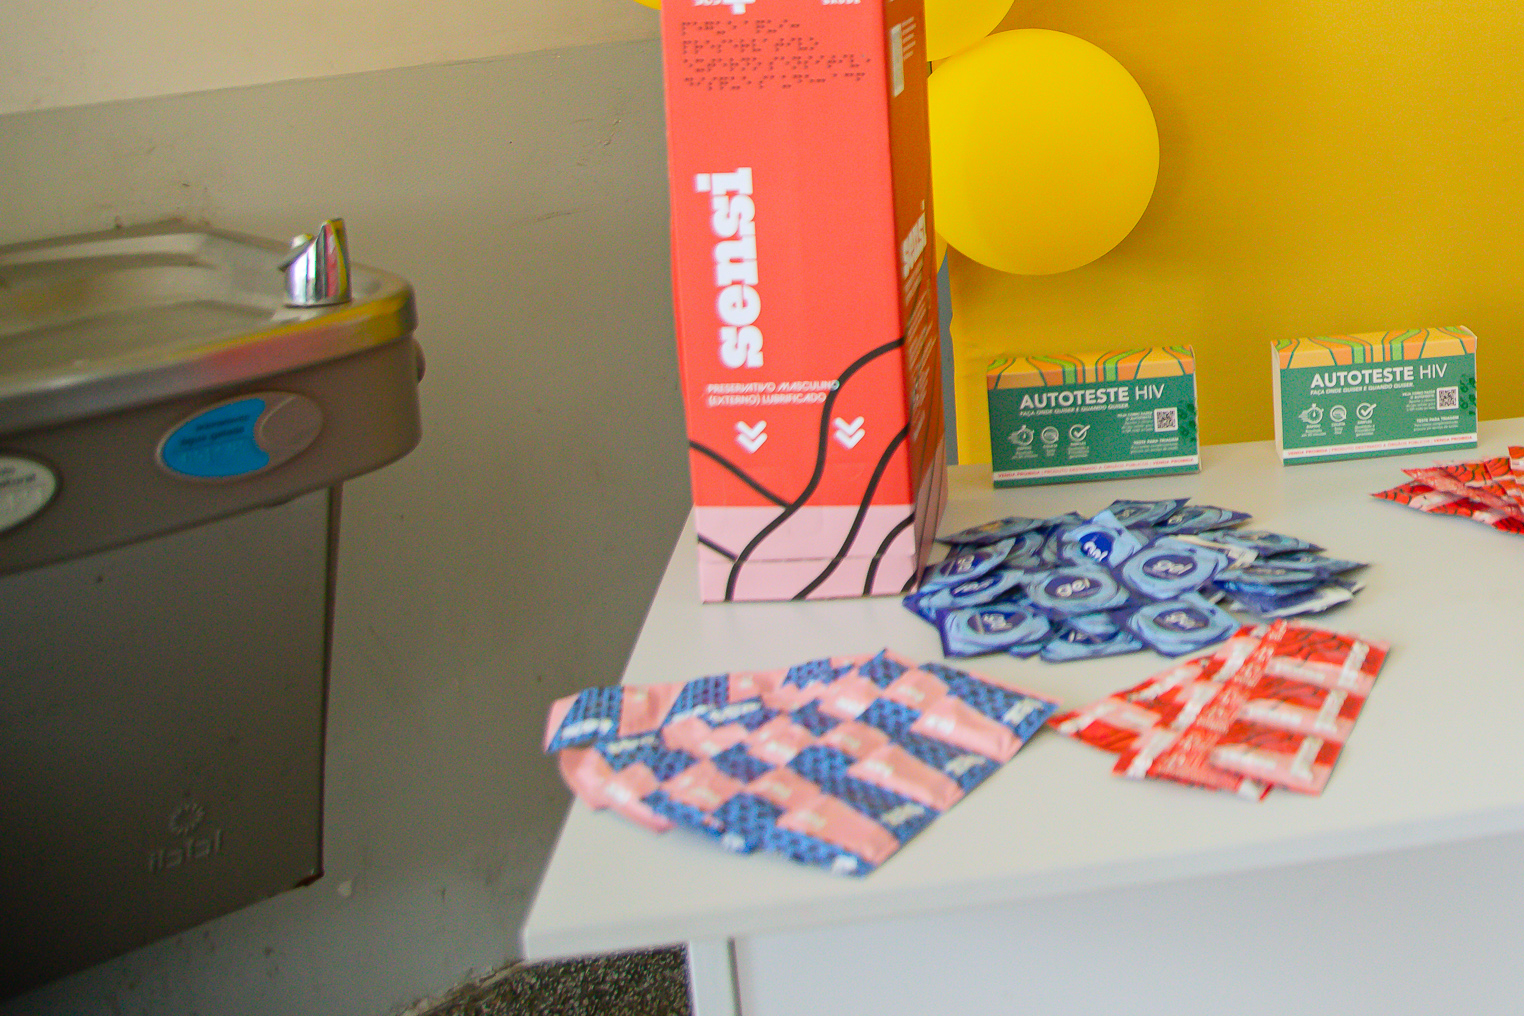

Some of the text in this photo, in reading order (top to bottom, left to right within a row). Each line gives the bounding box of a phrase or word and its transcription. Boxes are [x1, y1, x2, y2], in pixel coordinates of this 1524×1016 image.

[696, 167, 764, 368] sensi
[1310, 363, 1447, 389] AUTOTESTE HIV
[707, 379, 840, 394] PRESERVATIVO MASCULINO
[1310, 388, 1325, 396] FAÇA
[1368, 383, 1393, 391] QUANDO
[707, 392, 827, 407] (EXTERNO) LUBRIFICADO
[1020, 384, 1165, 410] AUTOTESTE HIV
